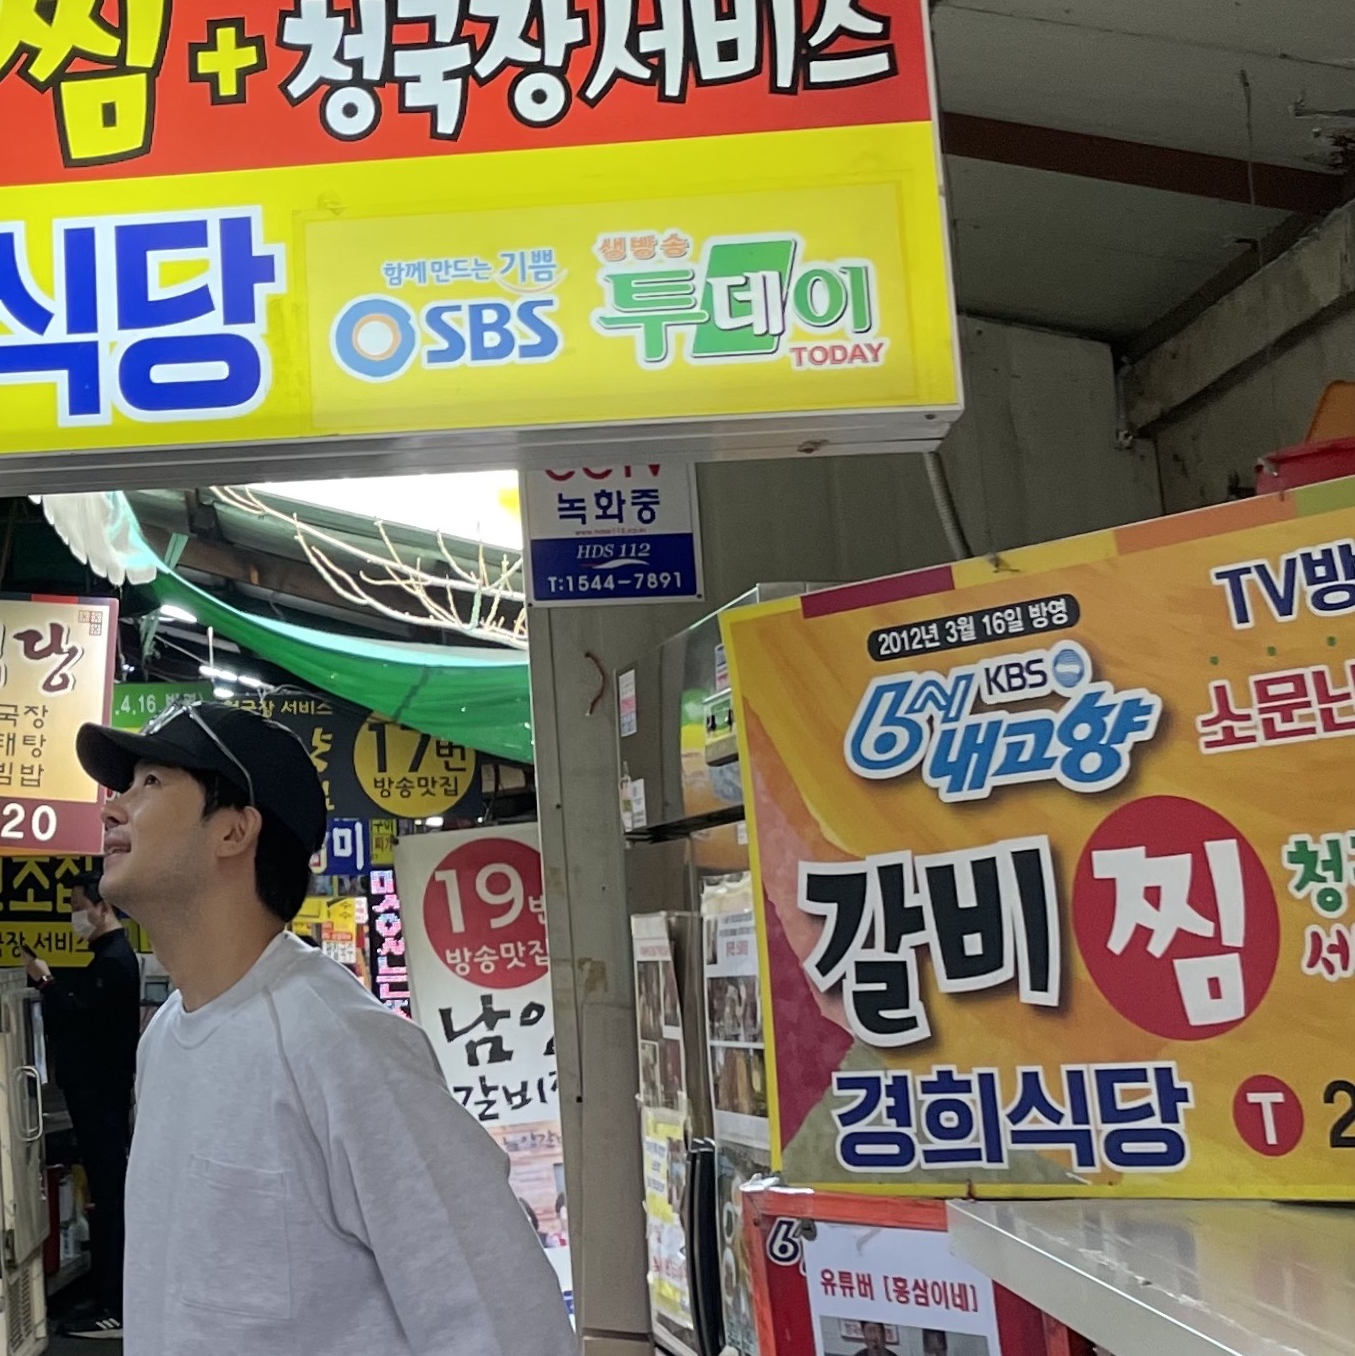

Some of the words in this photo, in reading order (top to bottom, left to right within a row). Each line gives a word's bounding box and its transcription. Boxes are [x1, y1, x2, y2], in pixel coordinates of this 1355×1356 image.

[598, 234, 691, 261] 생방송
[382, 260, 428, 287] 함께
[430, 259, 493, 285] 만드는
[499, 249, 558, 284] 기쁨
[598, 255, 874, 364] 투데이
[424, 298, 560, 366] SBS
[789, 342, 885, 369] TODAY
[557, 488, 661, 526] 녹화중
[576, 543, 615, 560] HDS
[618, 542, 651, 558] 112
[548, 571, 682, 593] T:1544-7891
[877, 621, 941, 656] 2012년
[945, 614, 975, 644] 3월
[980, 609, 1024, 639] 16일
[1028, 597, 1068, 629] 방영
[984, 655, 1048, 696] KBS
[280, 701, 334, 715] 서비스
[928, 690, 1156, 793] 내고향
[373, 775, 459, 798] 방송맛집
[453, 1071, 557, 1121] 갈비
[834, 1065, 1189, 1170] 경희식당
[819, 1267, 875, 1301] 유튜버
[882, 1274, 979, 1313] [홍삼이네]
